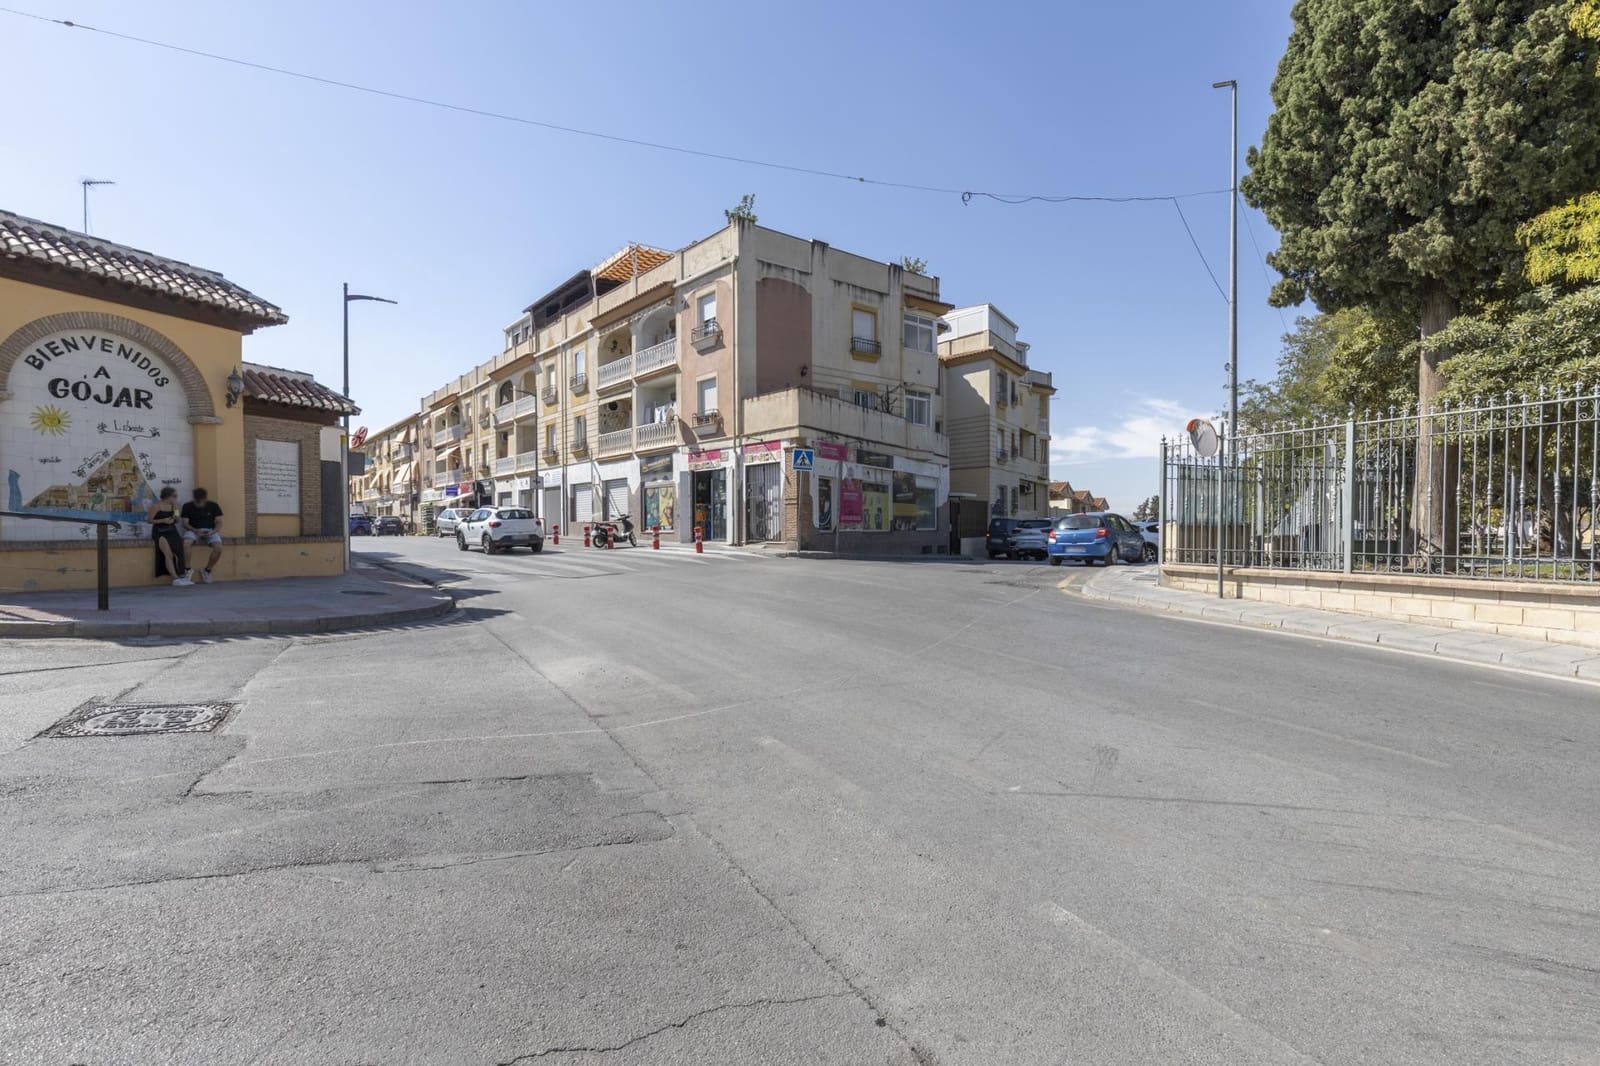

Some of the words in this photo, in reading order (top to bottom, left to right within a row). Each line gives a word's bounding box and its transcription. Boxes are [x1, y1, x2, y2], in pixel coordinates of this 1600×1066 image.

[24, 335, 170, 387] BIENVENIDOS
[93, 365, 111, 379] A
[48, 374, 153, 409] GÓJAR
